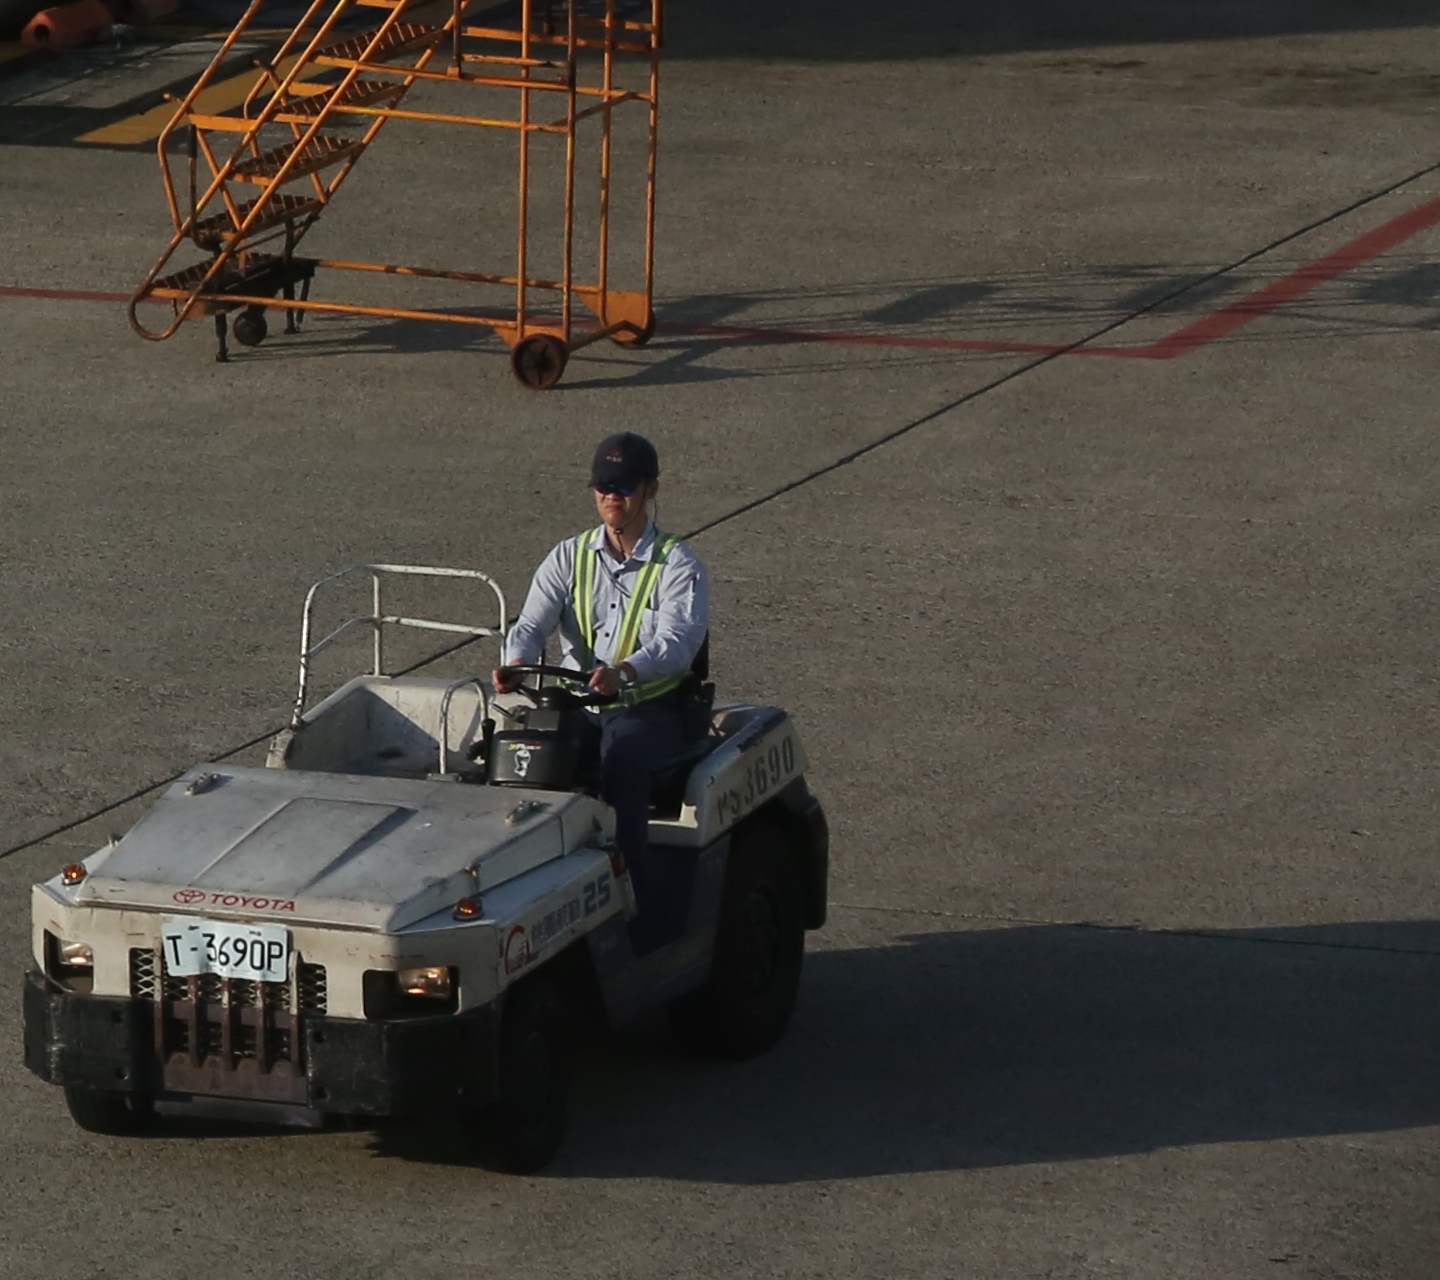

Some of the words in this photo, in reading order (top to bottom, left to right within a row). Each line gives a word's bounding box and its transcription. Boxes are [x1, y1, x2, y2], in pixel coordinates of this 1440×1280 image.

[210, 893, 296, 912] TOYOTA
[583, 872, 612, 919] 25
[166, 933, 284, 972] T-3690P
